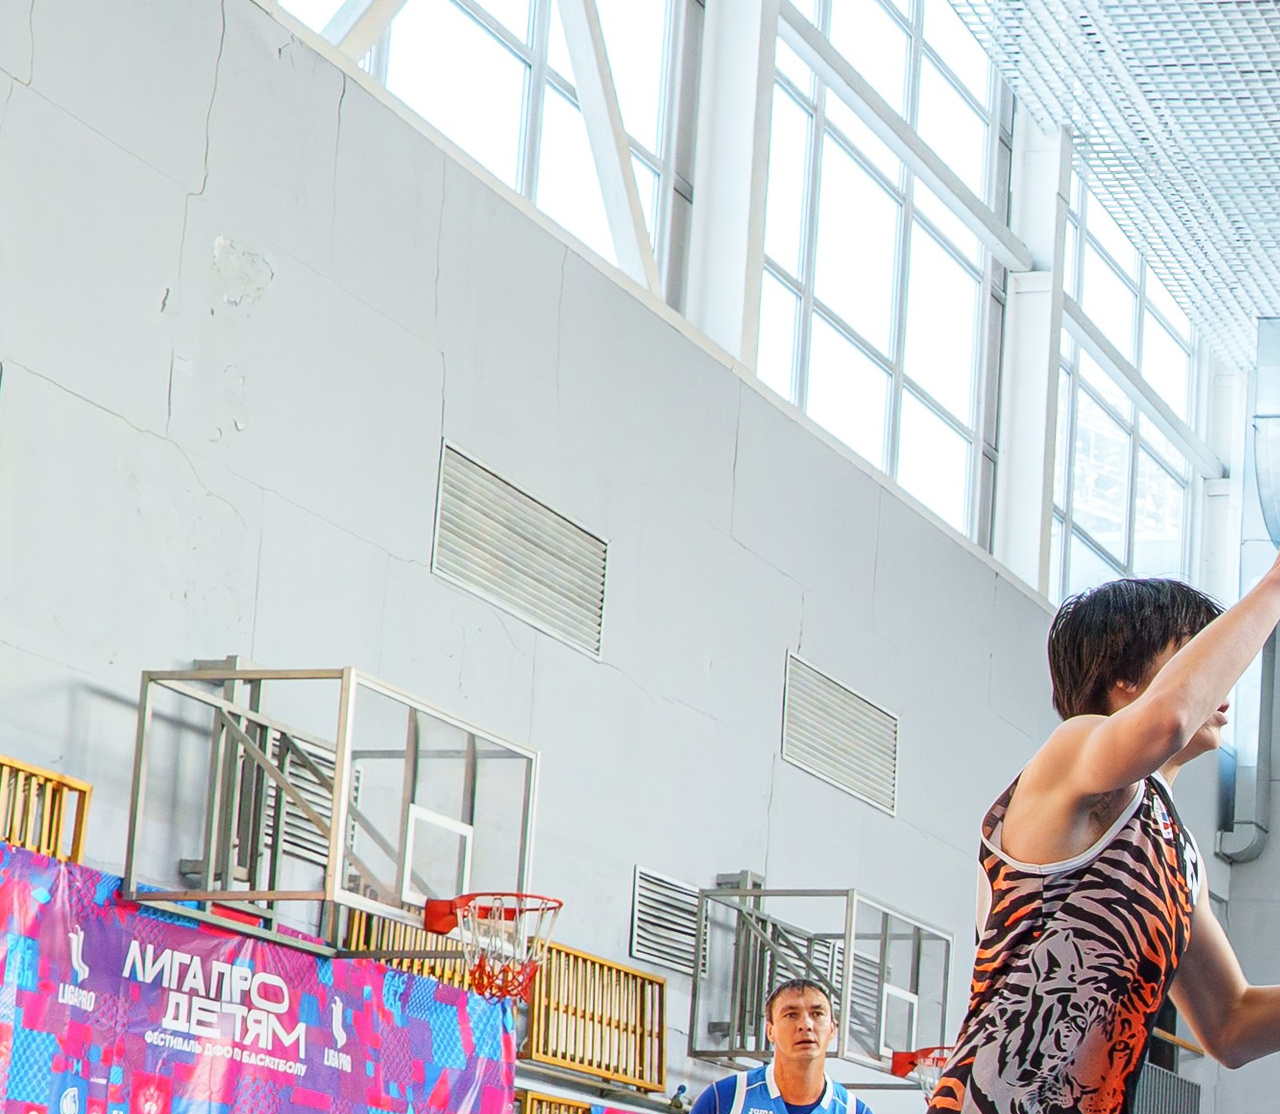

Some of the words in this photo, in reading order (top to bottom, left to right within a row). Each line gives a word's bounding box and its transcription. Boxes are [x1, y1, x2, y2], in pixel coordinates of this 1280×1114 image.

[144, 1030, 200, 1054] ФЕСТИВАЛЬ
[204, 1042, 233, 1059] ДФО
[161, 991, 307, 1059] ДЕТЯМ
